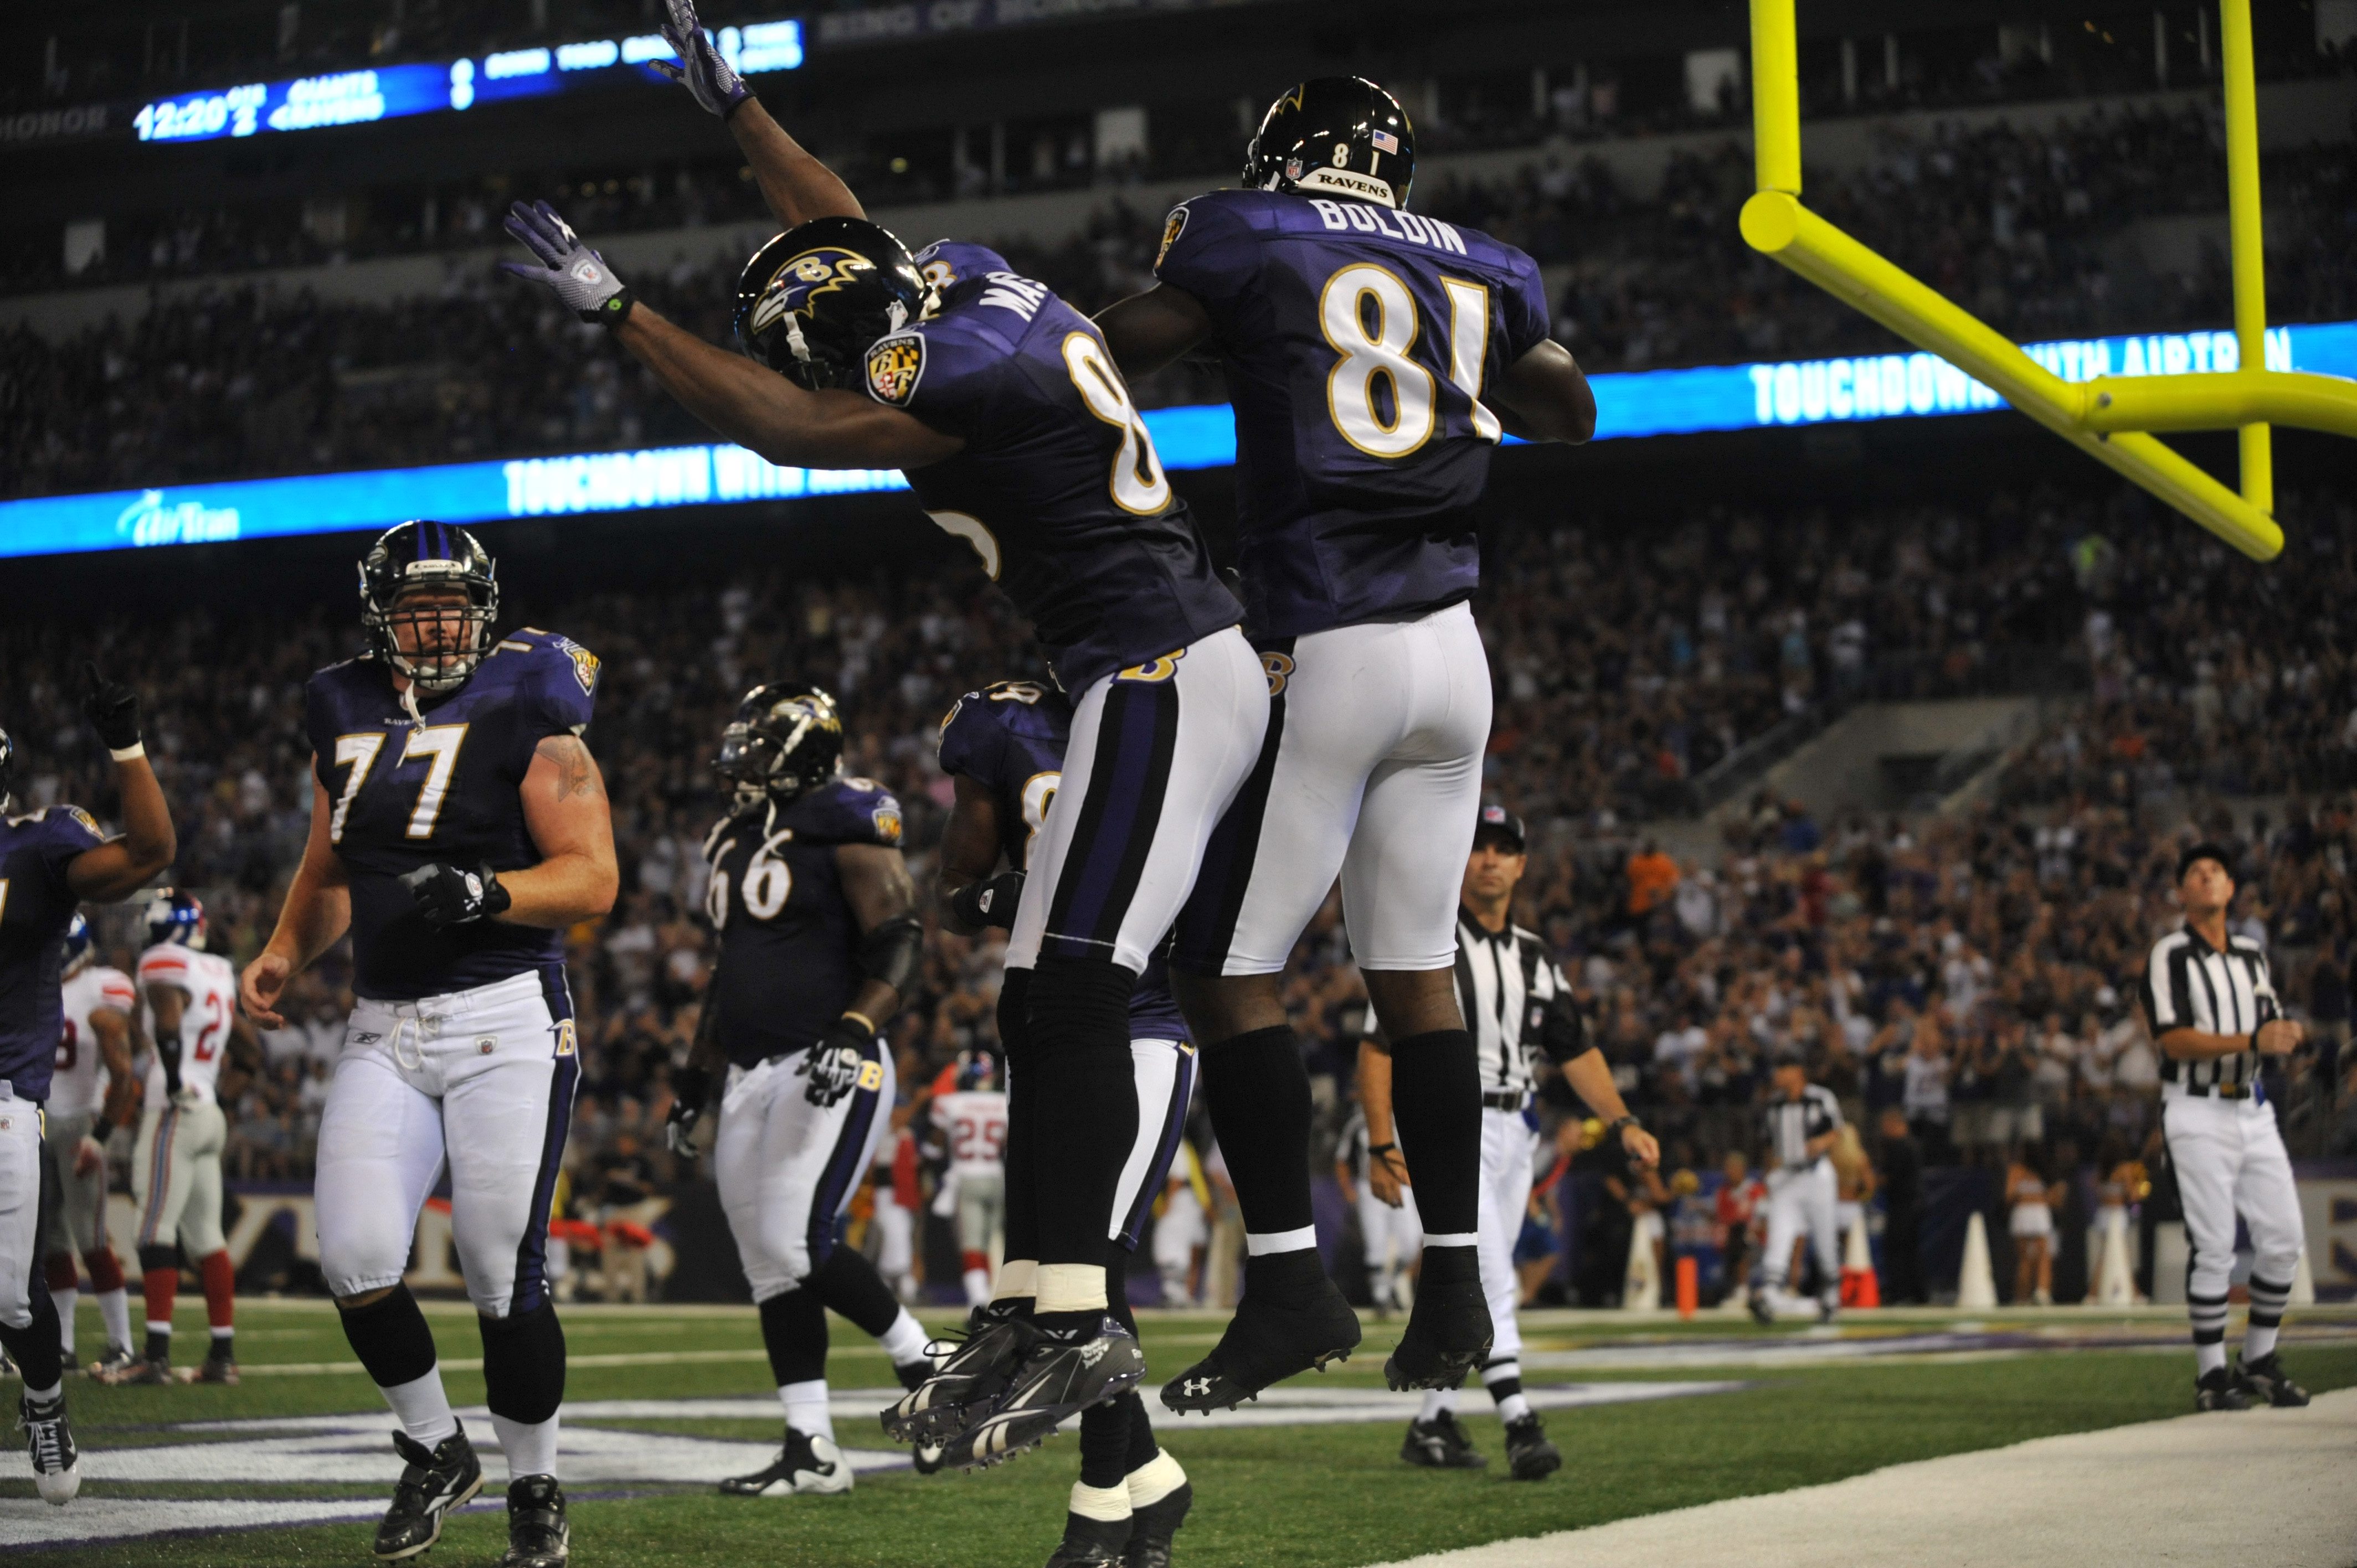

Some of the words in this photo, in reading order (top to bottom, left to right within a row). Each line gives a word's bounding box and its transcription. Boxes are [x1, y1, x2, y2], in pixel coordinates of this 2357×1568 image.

[133, 95, 228, 141] 12:20
[1317, 173, 1388, 198] RAVENS
[1309, 198, 1467, 255] BOLDIN
[870, 338, 915, 359] RAVENS
[1319, 262, 1502, 458] 81
[331, 722, 470, 844] 77
